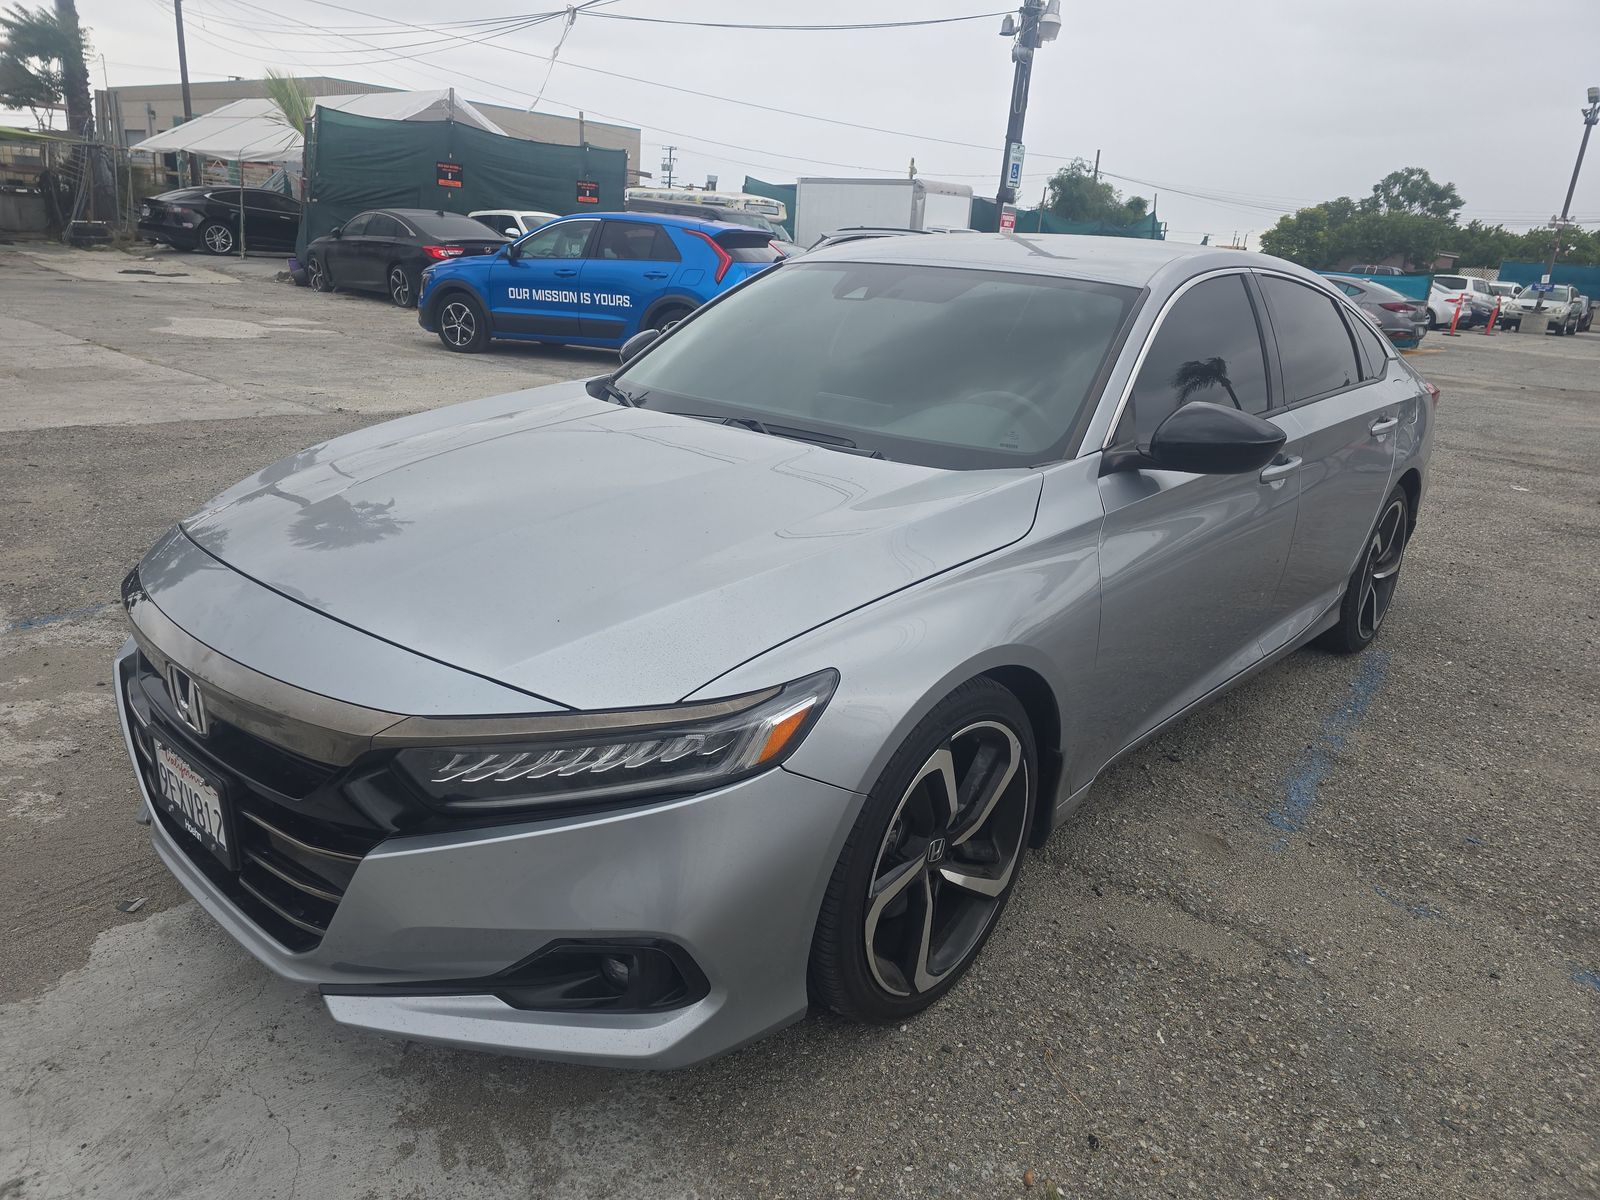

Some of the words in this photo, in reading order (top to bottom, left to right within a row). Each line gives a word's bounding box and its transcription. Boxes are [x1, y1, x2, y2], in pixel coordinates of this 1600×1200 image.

[508, 287, 530, 300] OUR
[532, 289, 578, 303] MISSION
[580, 292, 591, 304] IS
[593, 293, 633, 308] YOURS.
[165, 749, 203, 784] Californi
[159, 762, 227, 850] 9EXV812
